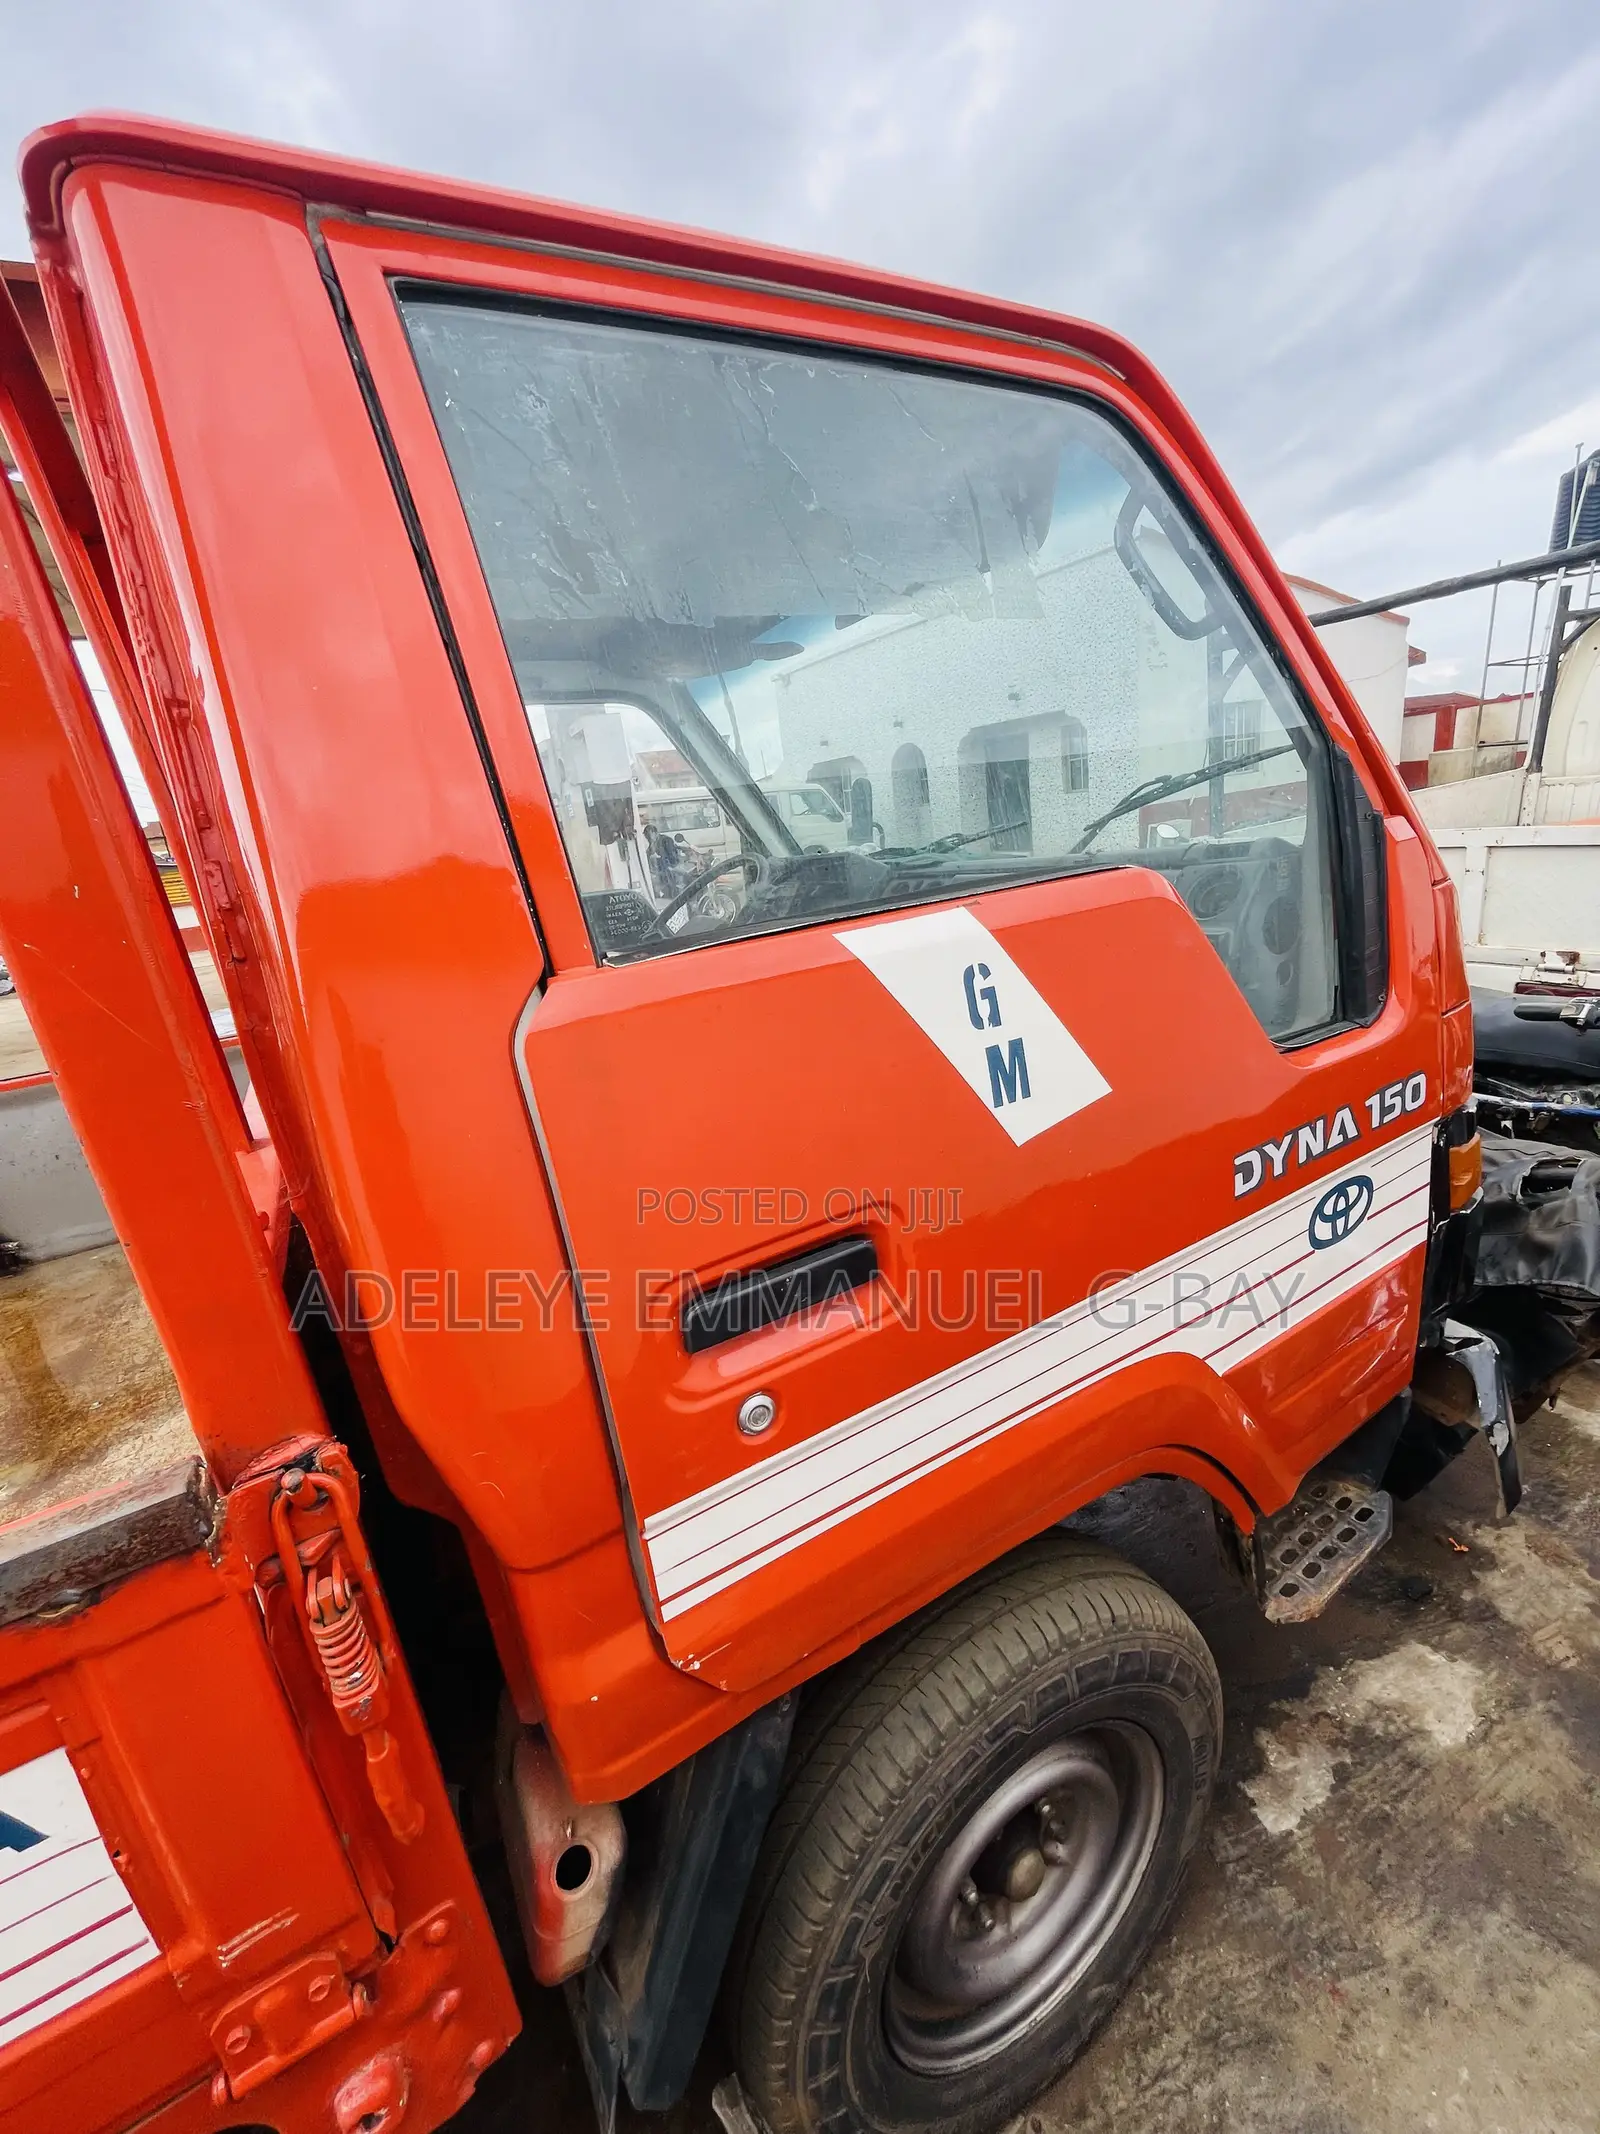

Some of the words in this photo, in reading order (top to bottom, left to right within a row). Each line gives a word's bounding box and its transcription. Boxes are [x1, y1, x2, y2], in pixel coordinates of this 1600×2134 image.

[963, 962, 1002, 1030] G
[985, 1037, 1031, 1109] M
[1233, 1105, 1361, 1198] DYNA
[1364, 1071, 1428, 1130] 150
